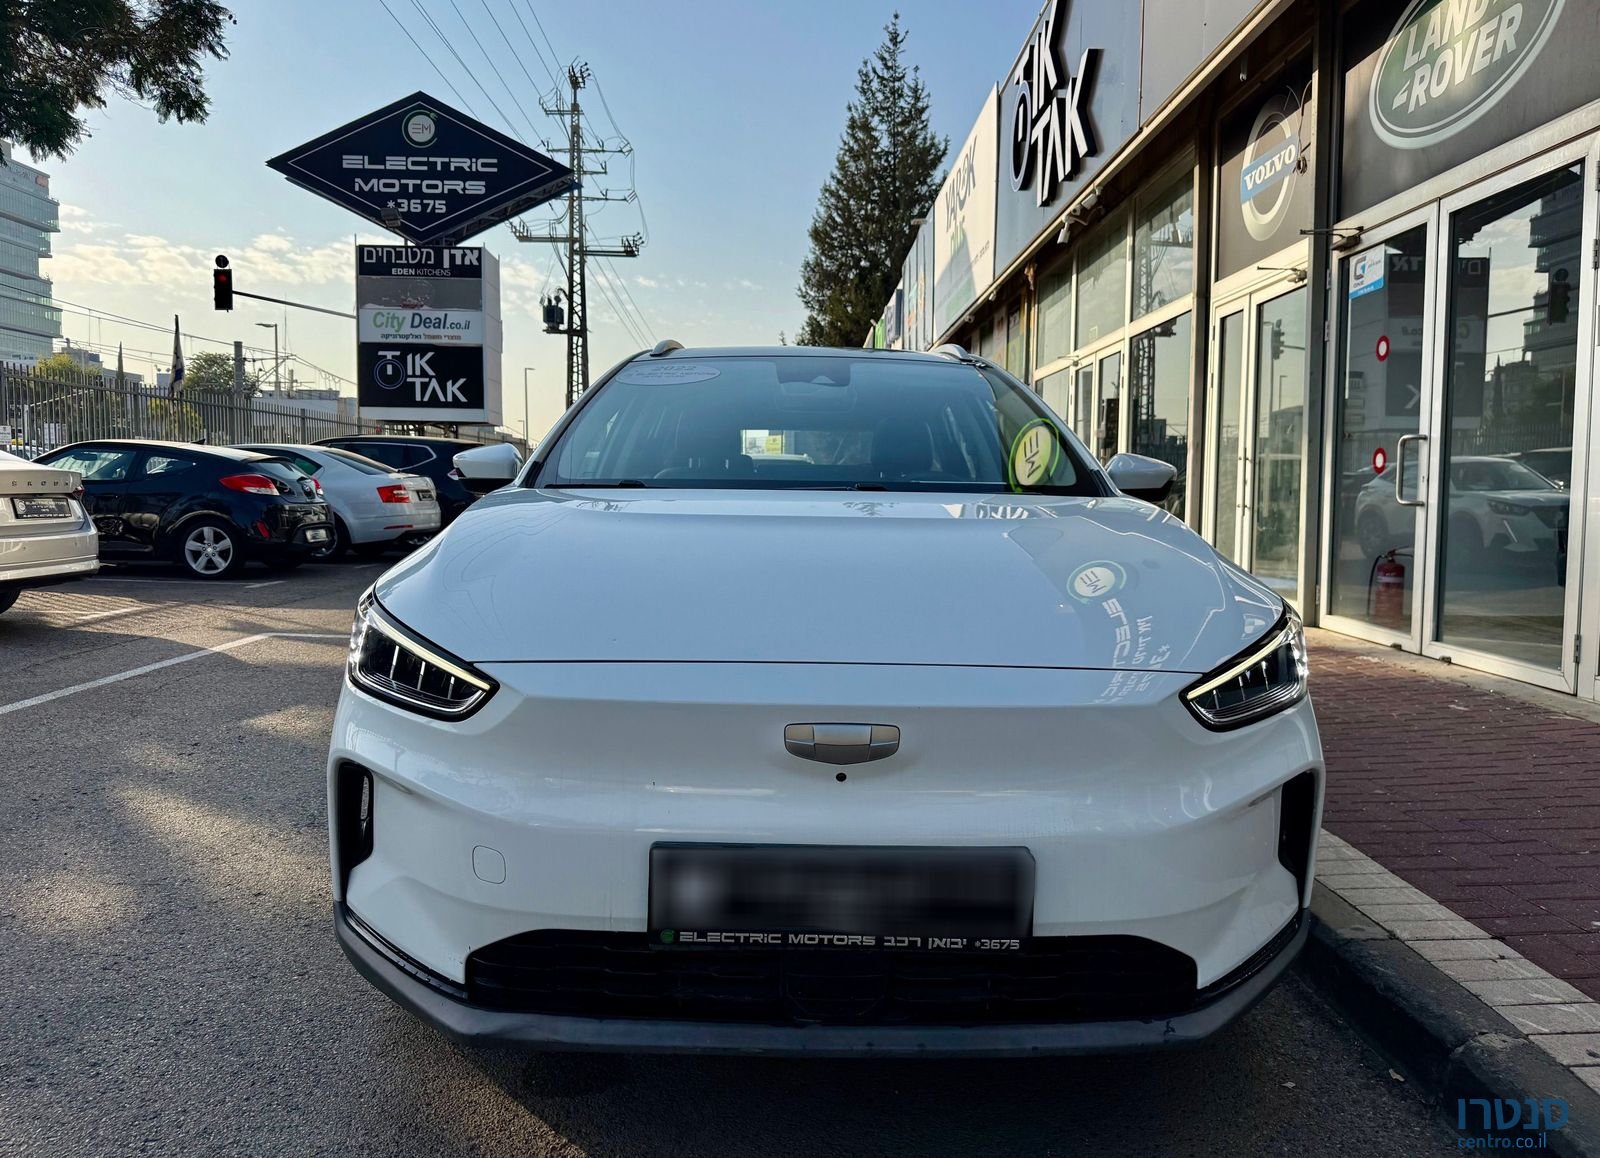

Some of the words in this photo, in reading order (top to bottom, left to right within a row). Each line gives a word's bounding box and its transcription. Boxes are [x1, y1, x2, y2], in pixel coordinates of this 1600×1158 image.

[1403, 0, 1488, 73] LAND
[1408, 2, 1523, 114] ROVER
[1244, 144, 1296, 190] VOLVO
[354, 178, 486, 195] MOTORS
[363, 247, 435, 265] מטבחים
[443, 248, 480, 268] אדן
[391, 268, 416, 276] EDEN
[416, 268, 451, 277] KITCHENS
[372, 312, 406, 333] City
[406, 377, 468, 402] TAK
[788, 934, 876, 947] MOTORS
[883, 936, 922, 948] רכב
[928, 937, 967, 950] יבואן
